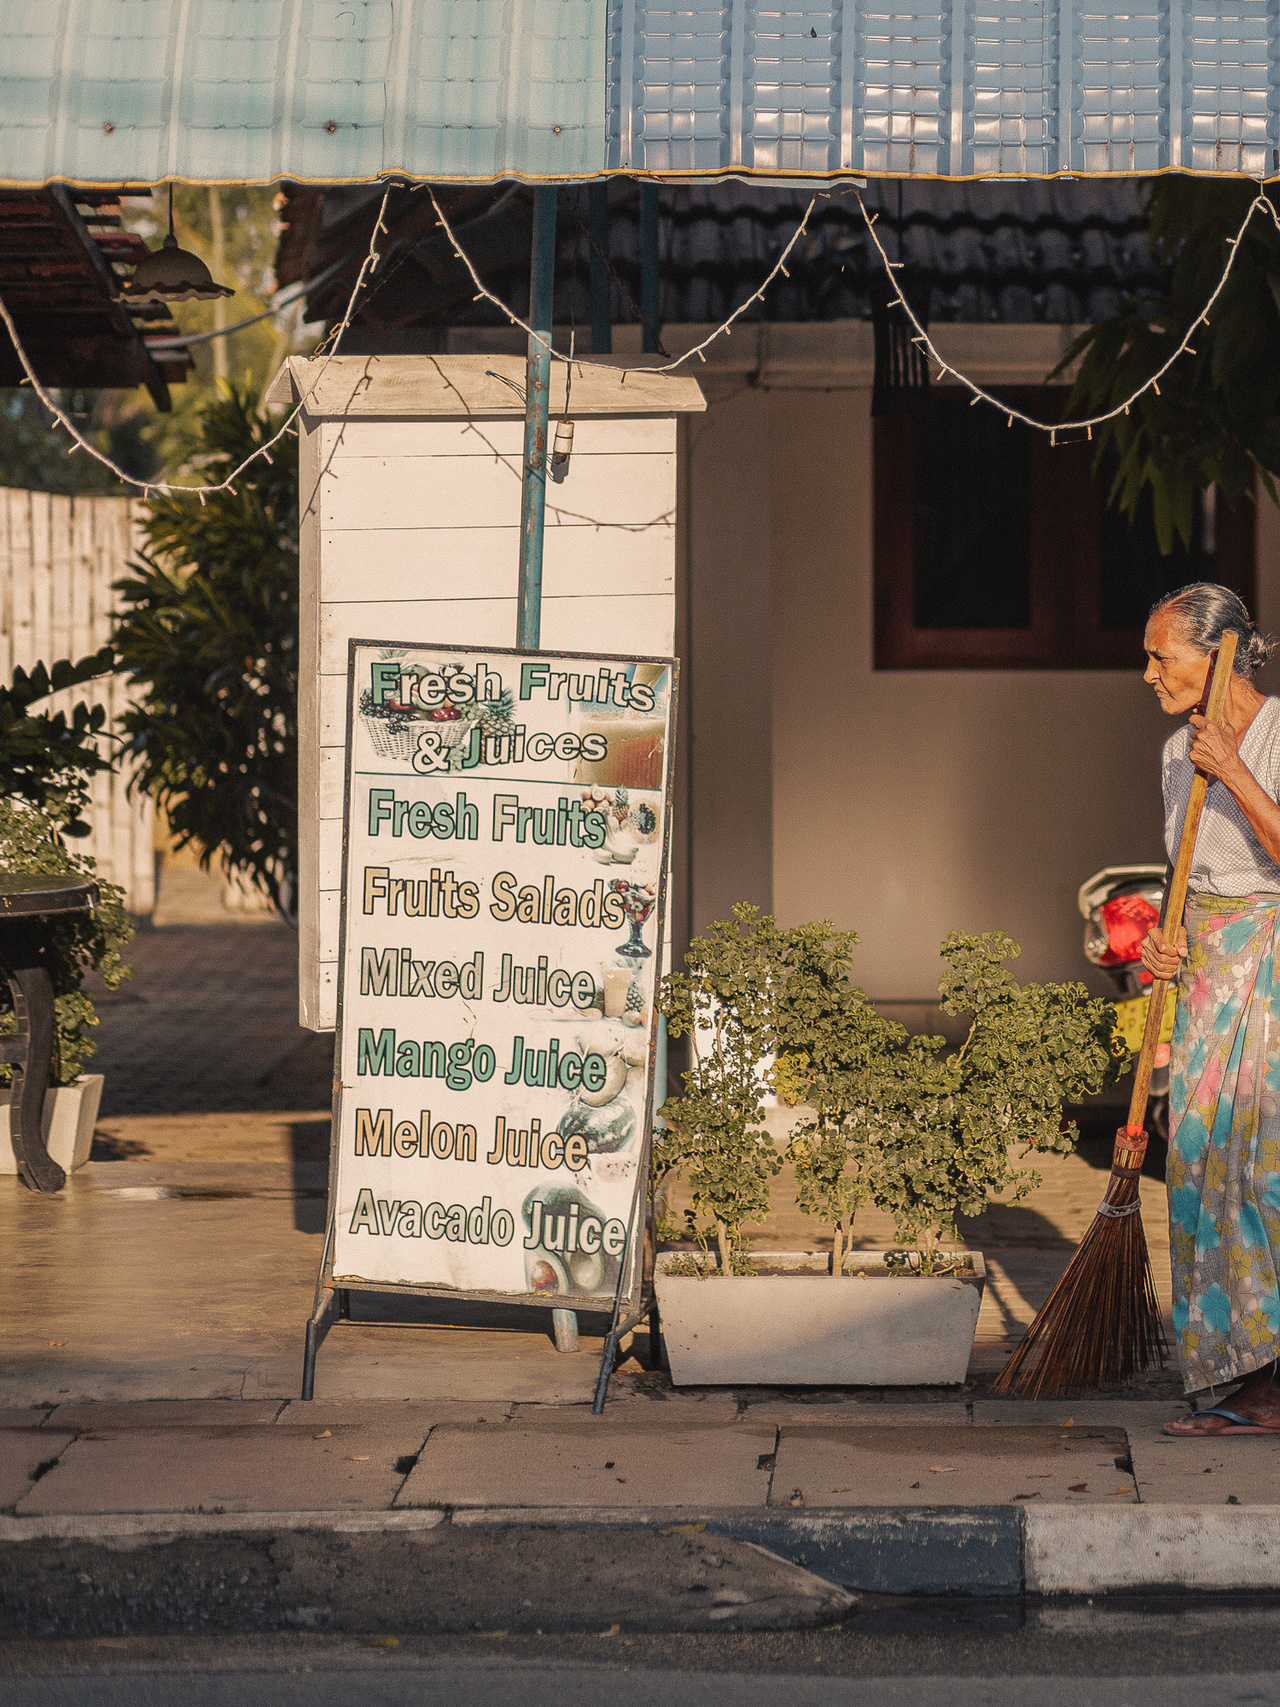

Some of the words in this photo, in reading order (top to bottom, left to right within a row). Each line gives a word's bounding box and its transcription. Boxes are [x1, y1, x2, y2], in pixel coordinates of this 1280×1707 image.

[371, 662, 502, 705] Fresh
[520, 662, 656, 712] Fruits
[412, 731, 451, 774] &
[463, 725, 608, 769] Juices
[368, 788, 479, 841] Fresh
[492, 794, 607, 849] Fruits
[363, 866, 480, 919] Fruits
[490, 871, 626, 930] Salads
[360, 947, 484, 1000] Mixed
[493, 953, 595, 1009] Juice
[357, 1028, 496, 1091] Mango
[504, 1036, 607, 1092] Juice
[354, 1108, 477, 1162] Melon
[487, 1116, 589, 1171] Juice
[349, 1188, 515, 1248] Avacado
[524, 1200, 627, 1256] Juice
